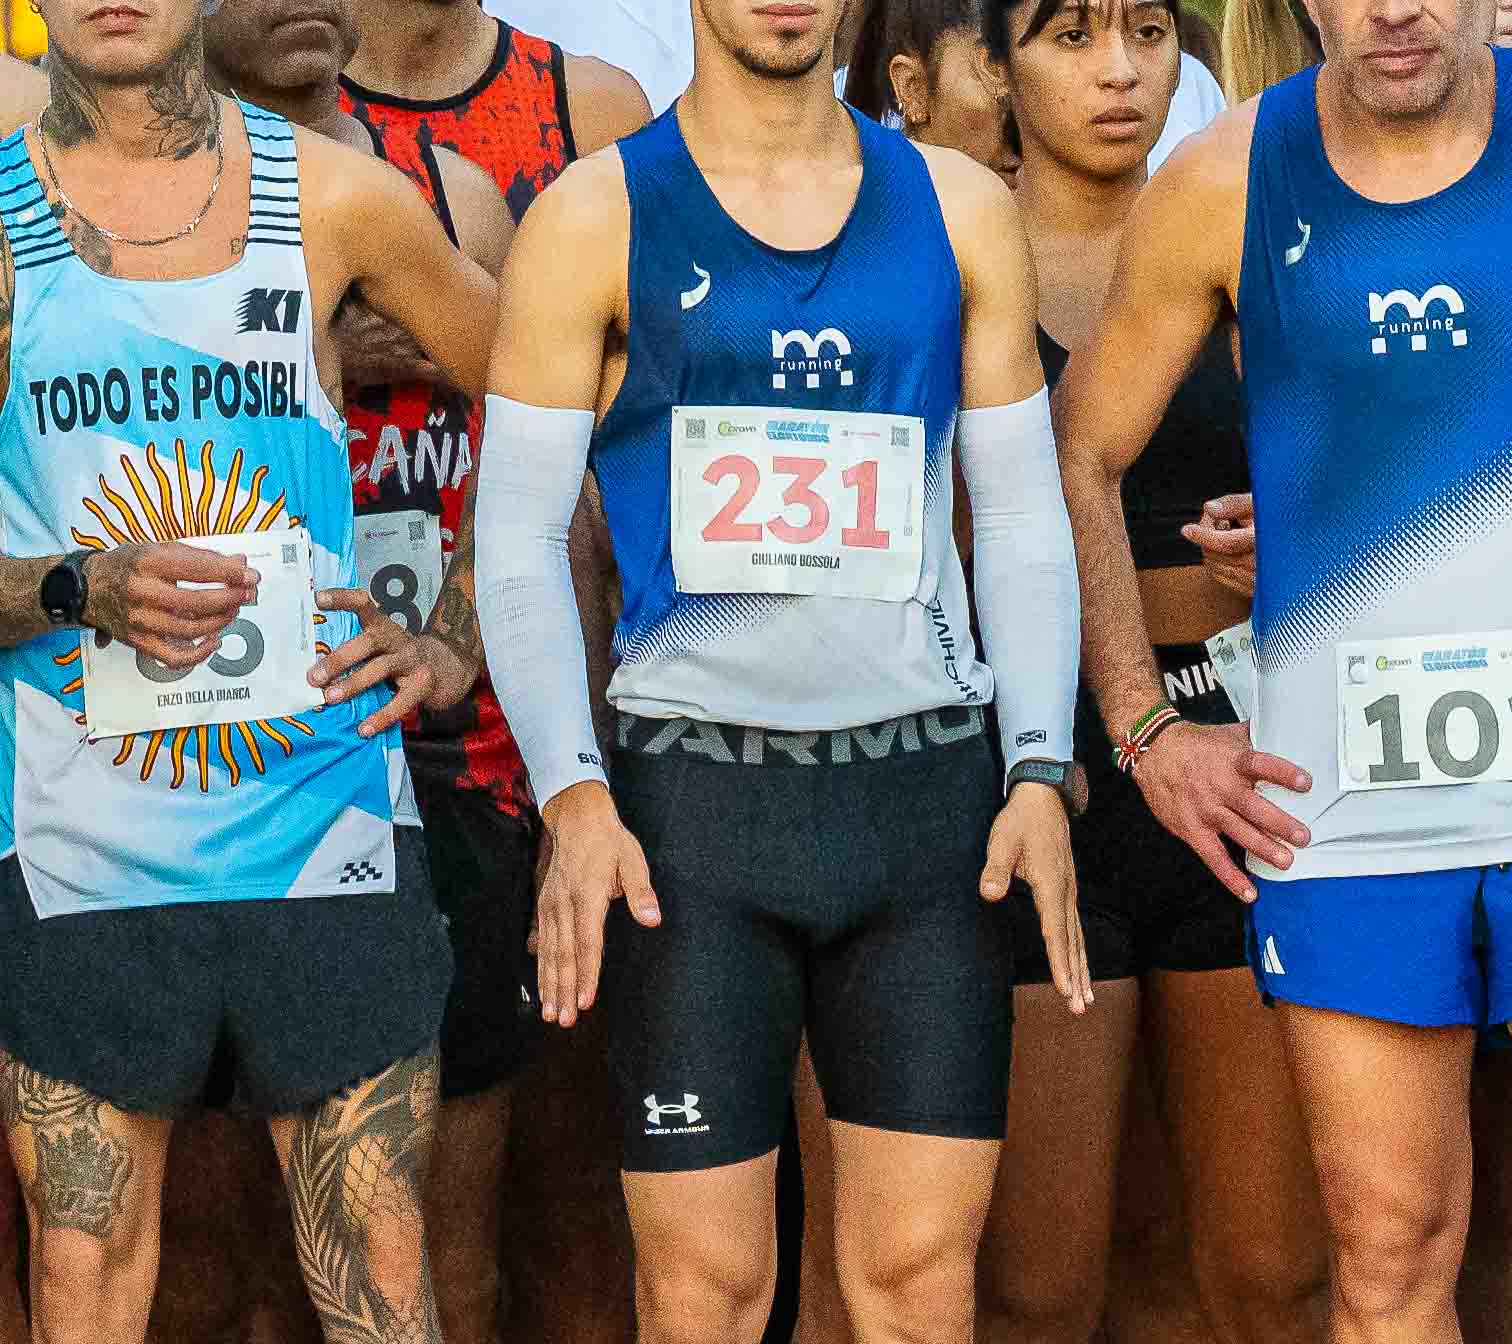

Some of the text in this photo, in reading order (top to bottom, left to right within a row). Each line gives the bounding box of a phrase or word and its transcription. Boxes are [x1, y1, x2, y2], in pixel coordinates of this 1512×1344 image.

[1378, 317, 1454, 335] running
[780, 358, 843, 372] running
[29, 360, 307, 436] TODO ES POSIBL
[702, 454, 890, 549] 231
[751, 553, 840, 569] GIULIANO BOSSOLA
[1164, 661, 1217, 701] NIK
[157, 687, 251, 708] ENZO DELLA BIANCA
[673, 1125, 710, 1134] ARMOUR
